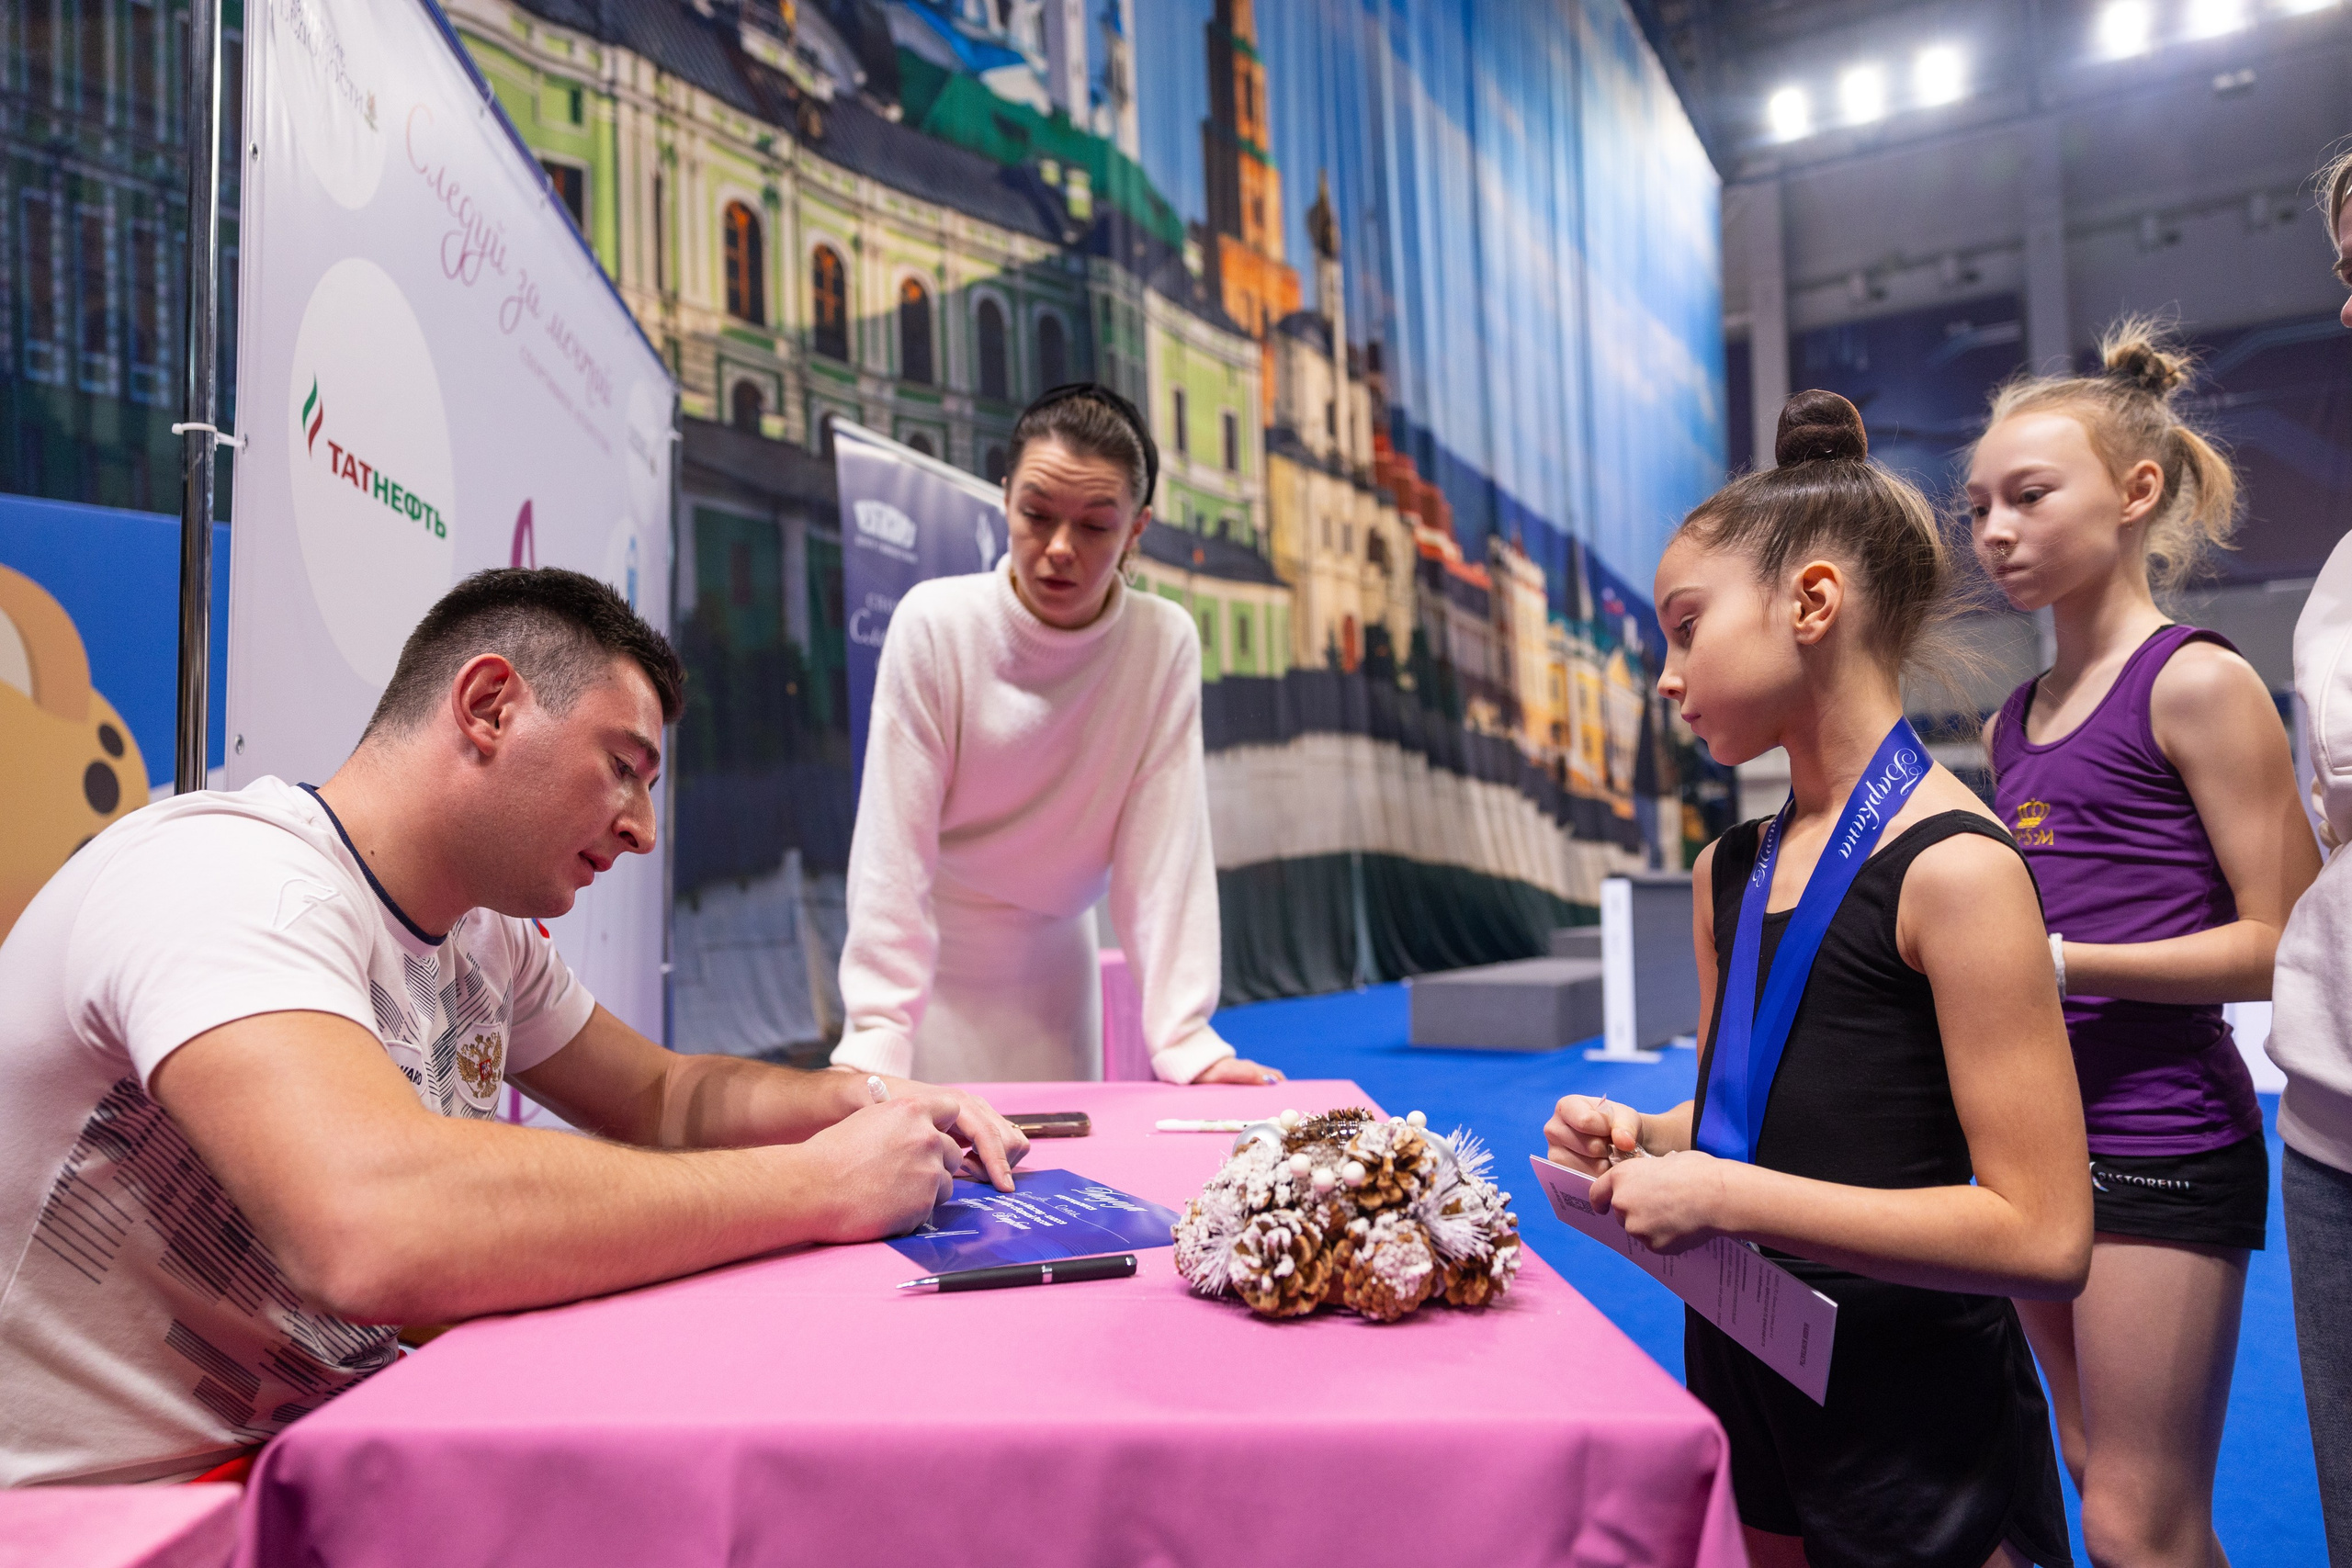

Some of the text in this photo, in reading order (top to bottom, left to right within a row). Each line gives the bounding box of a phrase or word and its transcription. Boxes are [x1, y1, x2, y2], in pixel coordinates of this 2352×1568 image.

[406, 103, 508, 288] Следуй
[499, 268, 542, 334] за
[327, 439, 447, 540] ТАТНЕФТЬ
